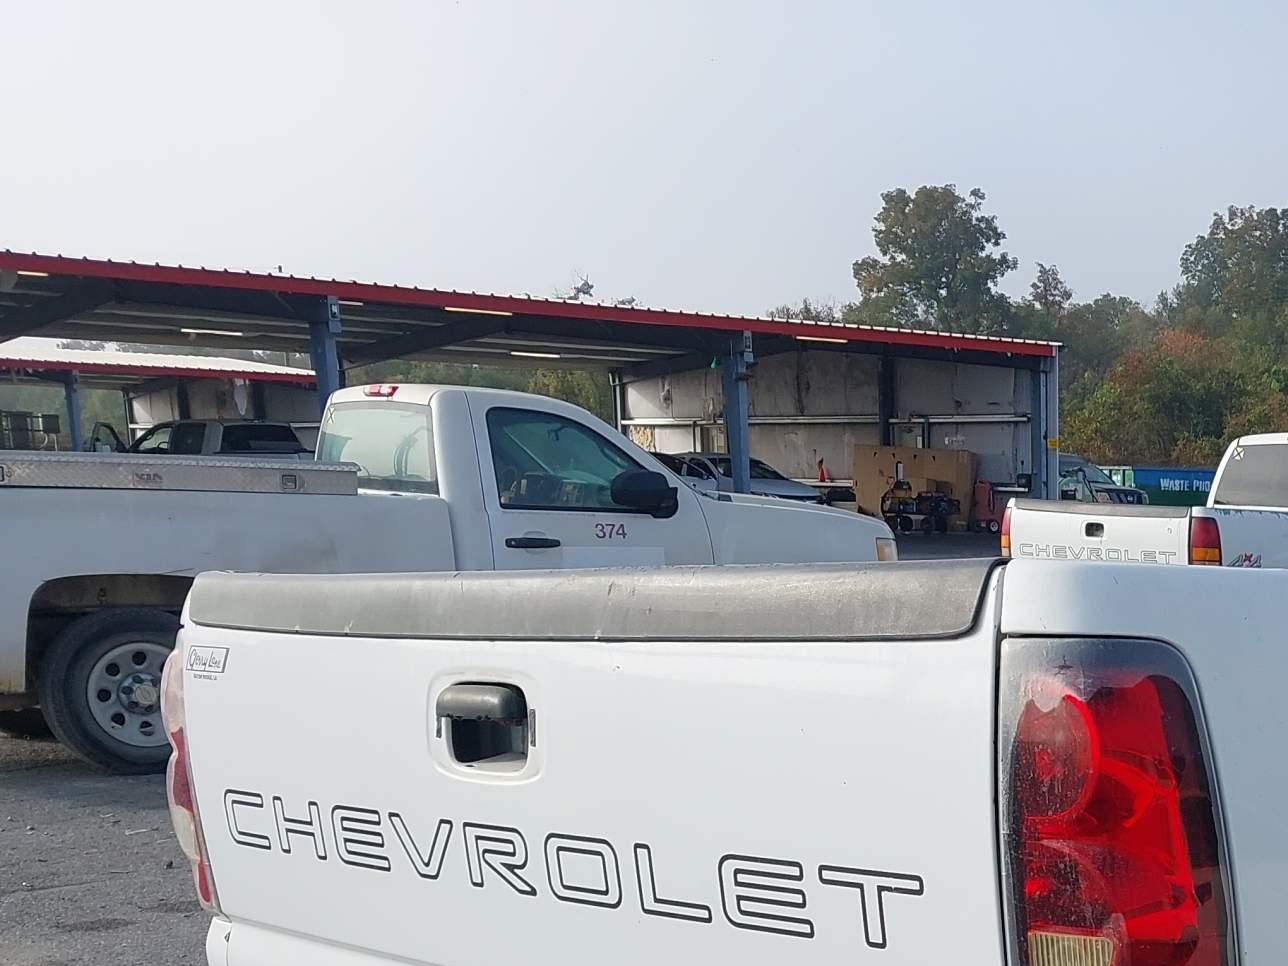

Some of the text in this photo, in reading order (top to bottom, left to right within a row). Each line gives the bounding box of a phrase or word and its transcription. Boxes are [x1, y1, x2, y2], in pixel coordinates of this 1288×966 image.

[1160, 478, 1190, 492] WASTE
[595, 523, 627, 539] 374
[1019, 543, 1177, 564] CHEVROLET
[223, 789, 925, 949] CHEVROLET
